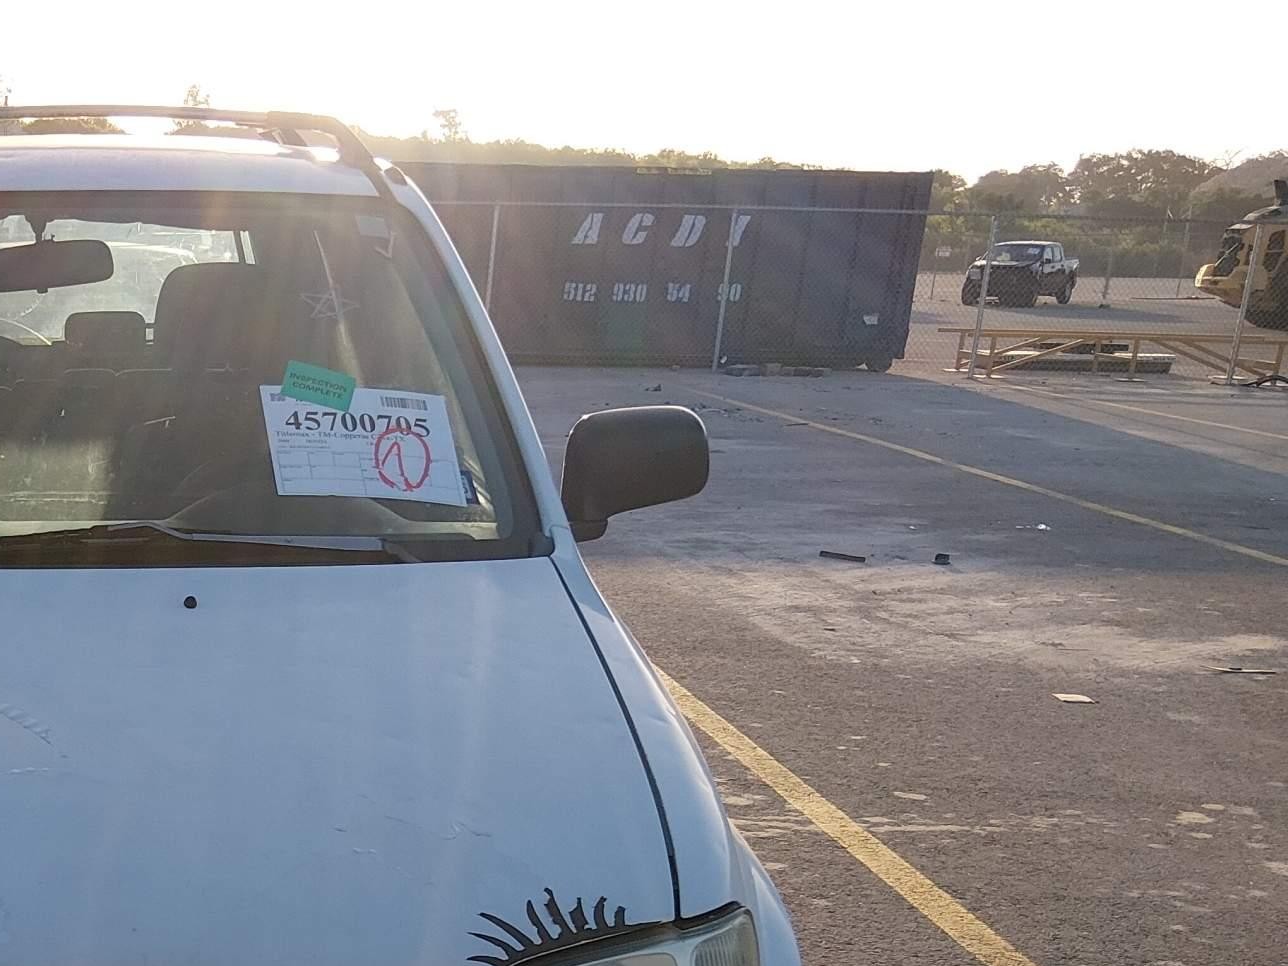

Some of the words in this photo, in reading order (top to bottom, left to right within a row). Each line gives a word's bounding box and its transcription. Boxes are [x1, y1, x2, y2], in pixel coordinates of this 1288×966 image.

[563, 283, 596, 302] 512
[612, 282, 647, 303] 930
[666, 282, 692, 303] 54
[289, 372, 347, 393] INSPECTION
[293, 381, 344, 400] COMPLETE
[286, 411, 431, 437] 45700705
